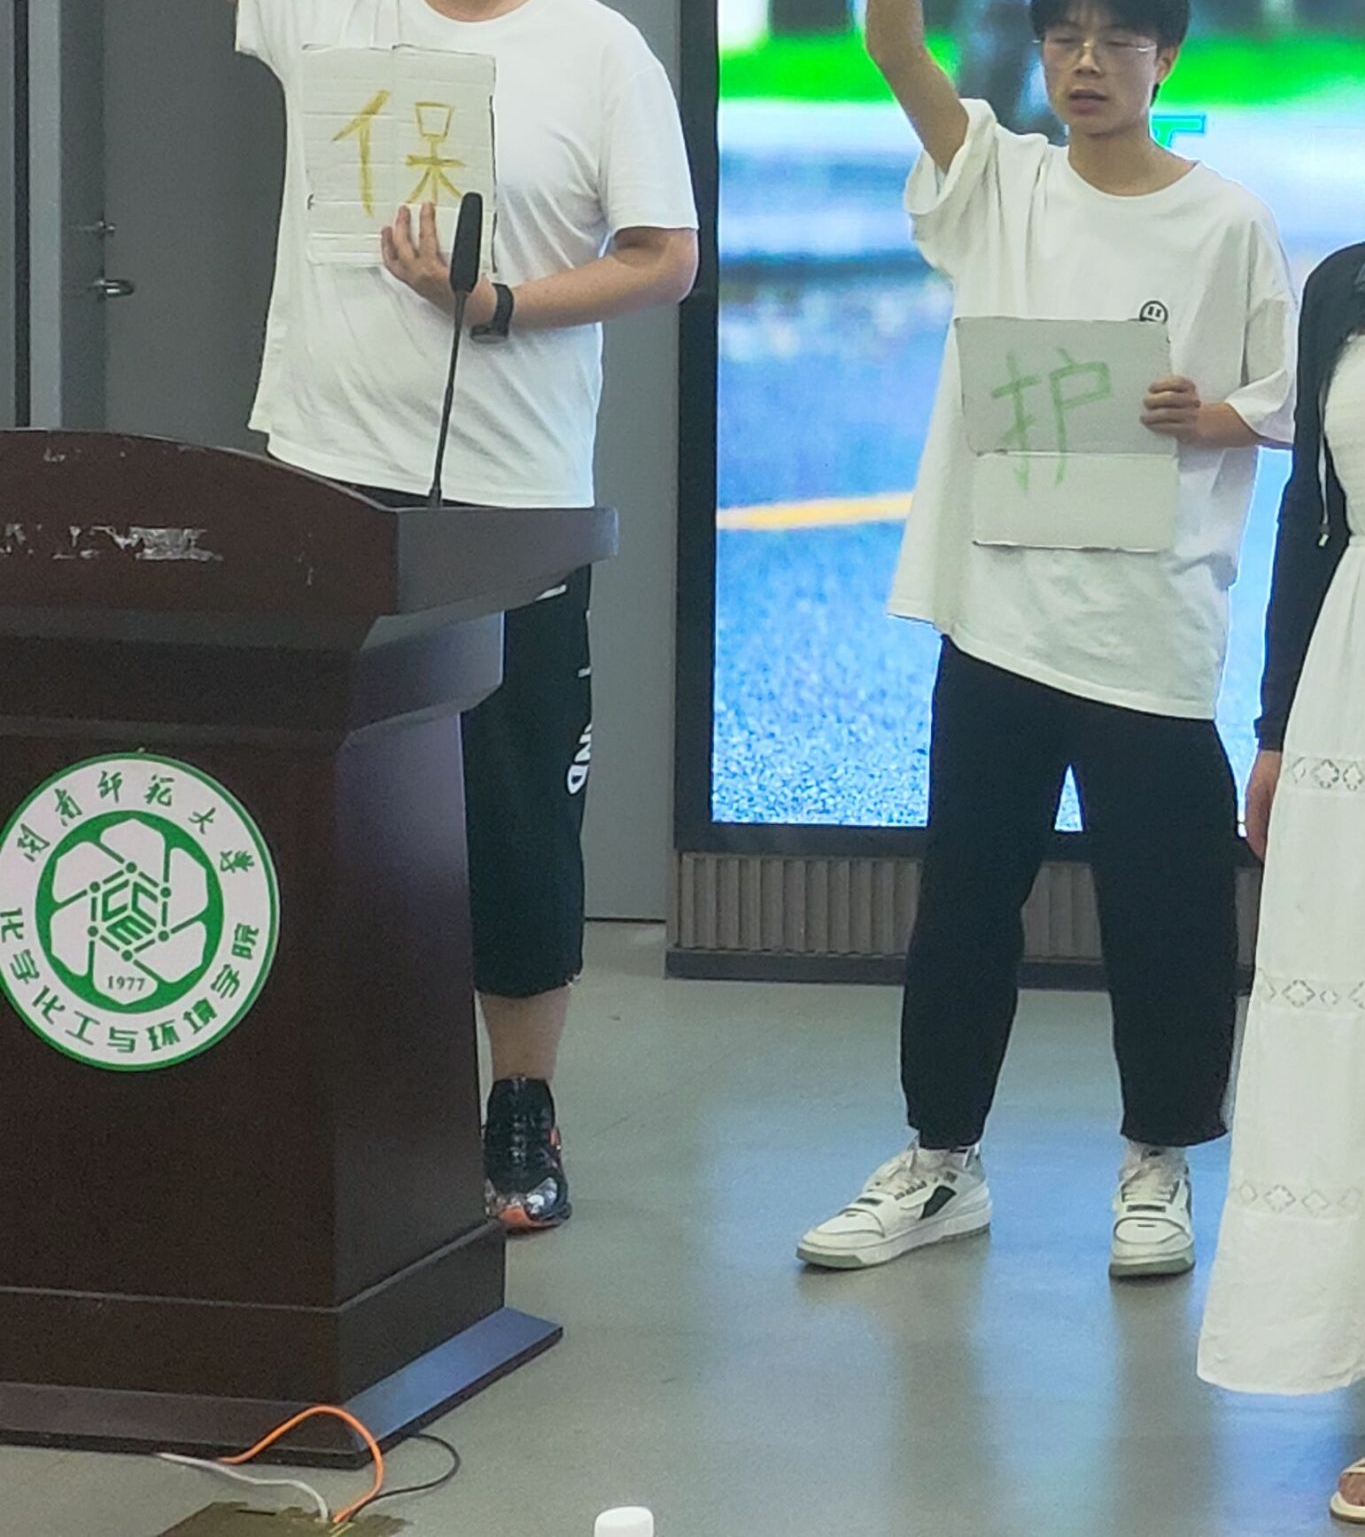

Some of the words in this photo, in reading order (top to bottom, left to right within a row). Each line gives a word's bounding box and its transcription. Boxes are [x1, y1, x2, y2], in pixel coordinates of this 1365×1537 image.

[330, 89, 468, 218] 保
[991, 347, 1112, 494] 护
[106, 974, 146, 992] 1977
